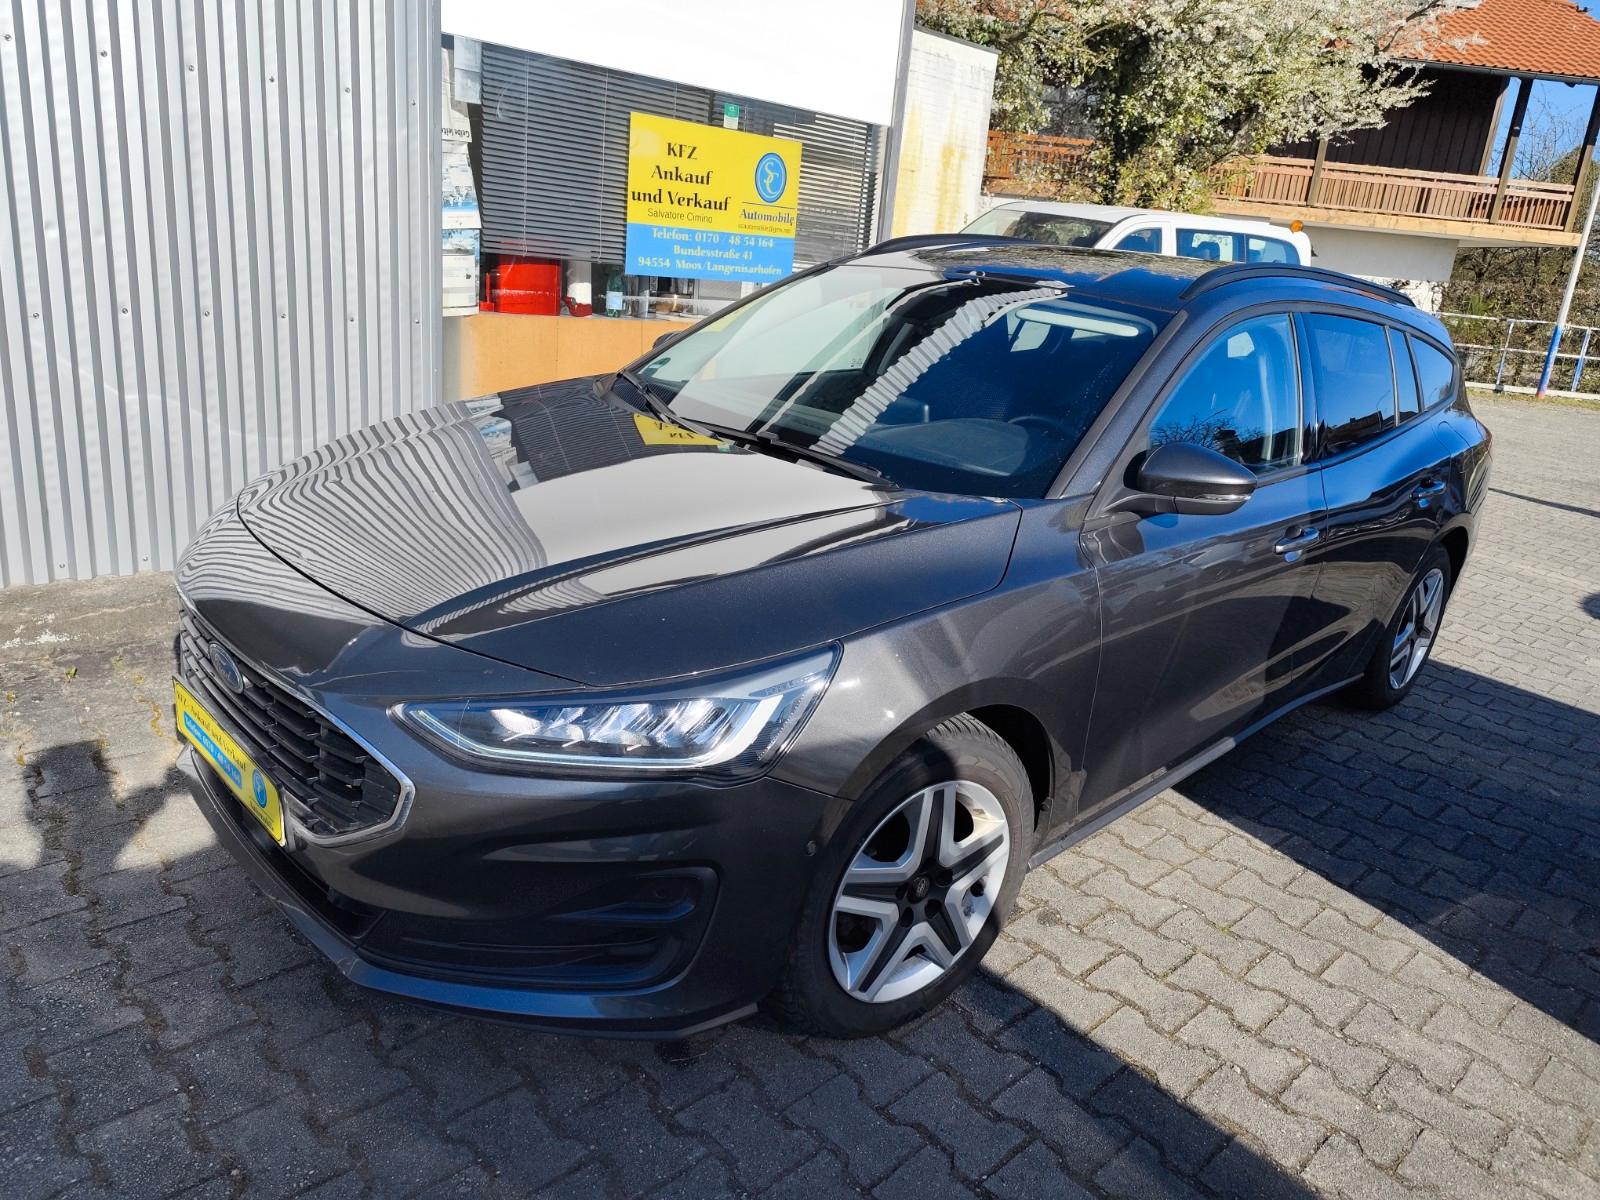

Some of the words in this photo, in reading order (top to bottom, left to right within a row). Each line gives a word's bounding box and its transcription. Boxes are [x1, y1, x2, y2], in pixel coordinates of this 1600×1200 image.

[666, 142, 698, 160] KFZ
[651, 165, 714, 186] Ankauf
[631, 188, 663, 204] und
[667, 190, 732, 211] Verkauf
[647, 208, 685, 221] Salvatore
[739, 208, 795, 226] Automobile
[652, 227, 692, 241] Telefon:
[695, 232, 719, 244] 0170
[728, 235, 741, 246] 48
[743, 236, 756, 247] 54
[757, 237, 774, 249] 164
[673, 245, 741, 260] Bundesstraße
[742, 249, 753, 261] 41
[637, 256, 671, 269] 94554
